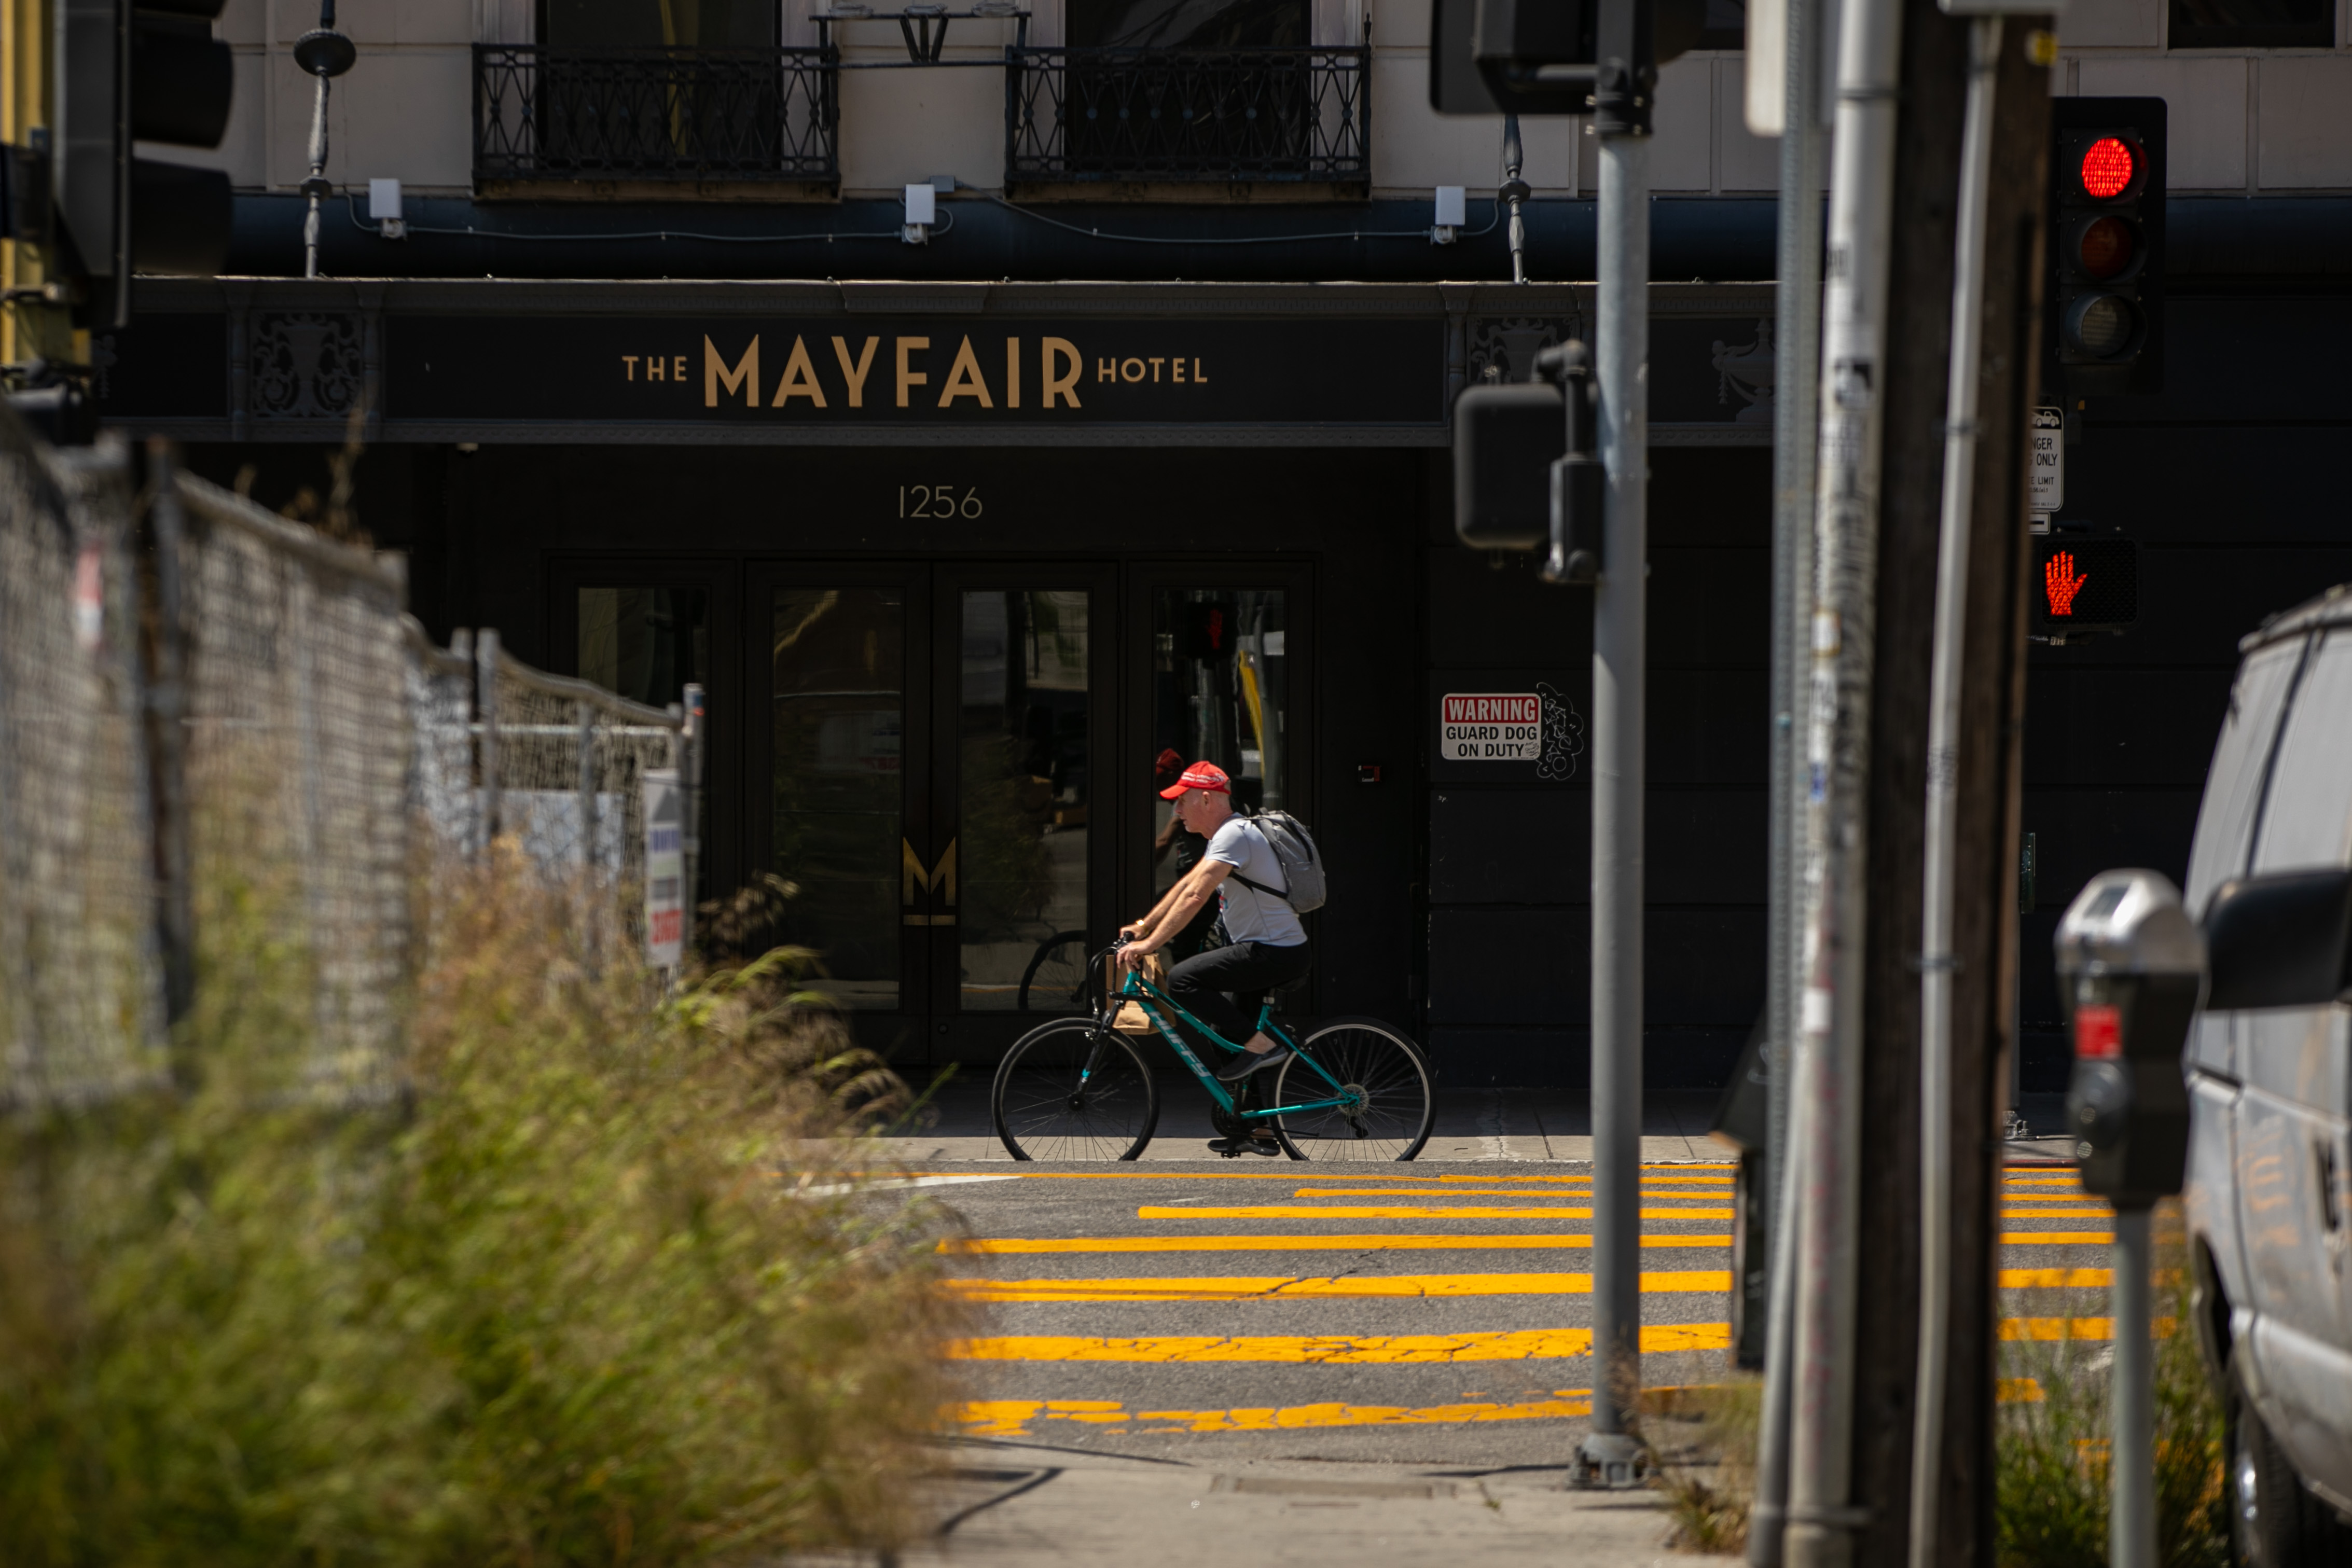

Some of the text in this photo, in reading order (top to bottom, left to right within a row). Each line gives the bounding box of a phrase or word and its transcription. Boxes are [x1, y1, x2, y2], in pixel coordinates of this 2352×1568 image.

[622, 334, 1208, 408] THE MAYFAIR HOTEL
[2037, 453, 2058, 466] ONLY
[2038, 476, 2054, 485] LIMIT
[900, 485, 983, 519] 1256
[1448, 699, 1535, 721] WARNING
[1446, 726, 1537, 740] GUARD DOG
[1458, 743, 1478, 757] ON
[1485, 743, 1524, 757] DUTY
